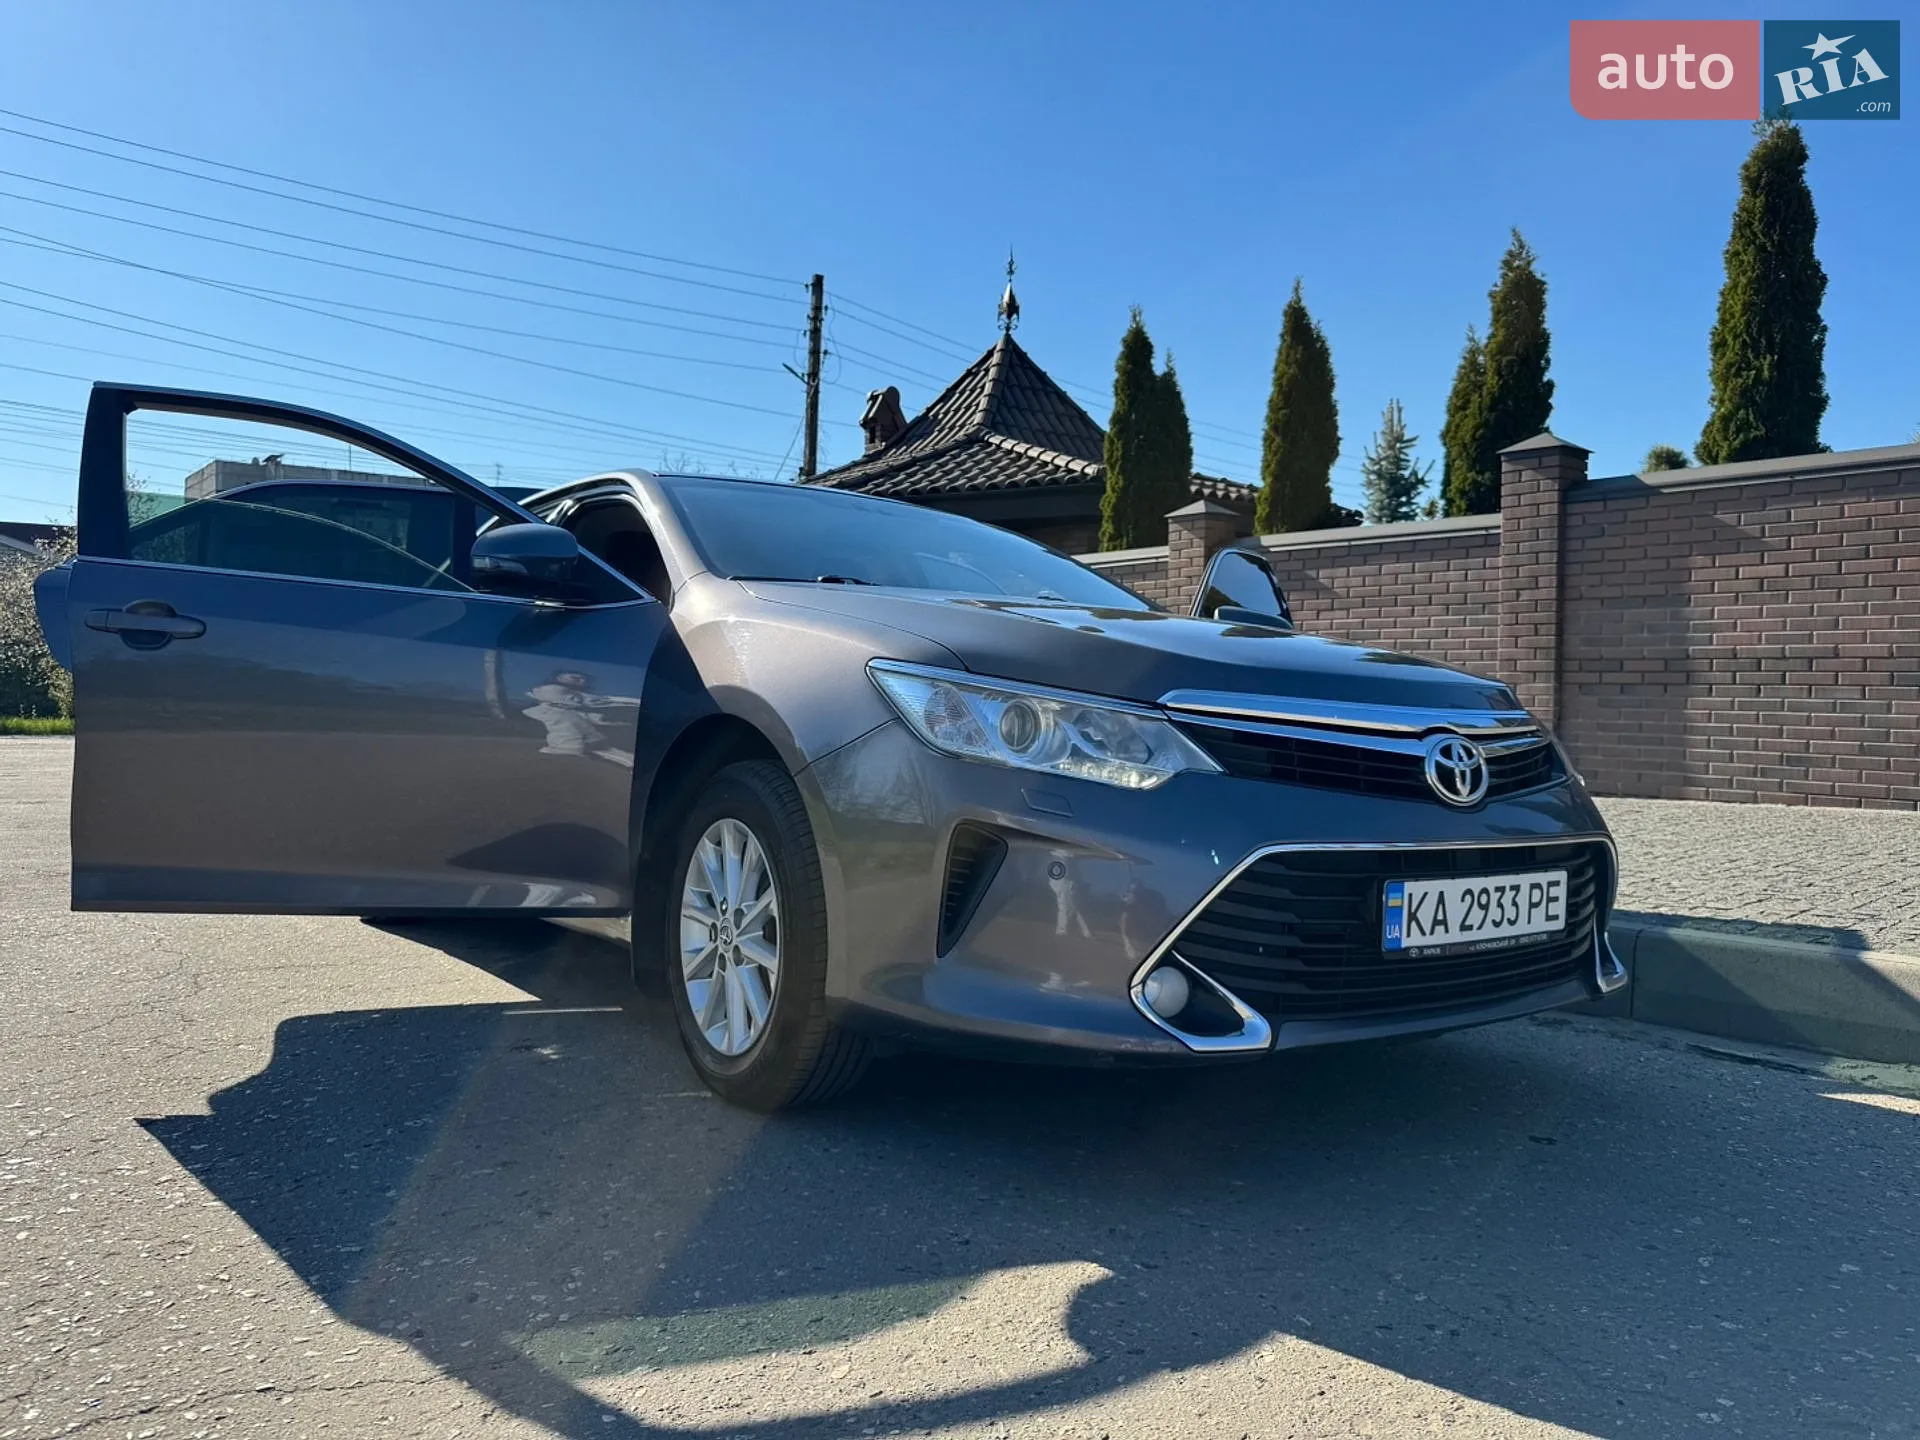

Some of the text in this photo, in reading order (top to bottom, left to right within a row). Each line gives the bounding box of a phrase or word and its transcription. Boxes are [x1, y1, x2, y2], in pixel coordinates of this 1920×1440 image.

[1406, 880, 1561, 938] KA 2933 PE
[1386, 924, 1400, 939] UA
